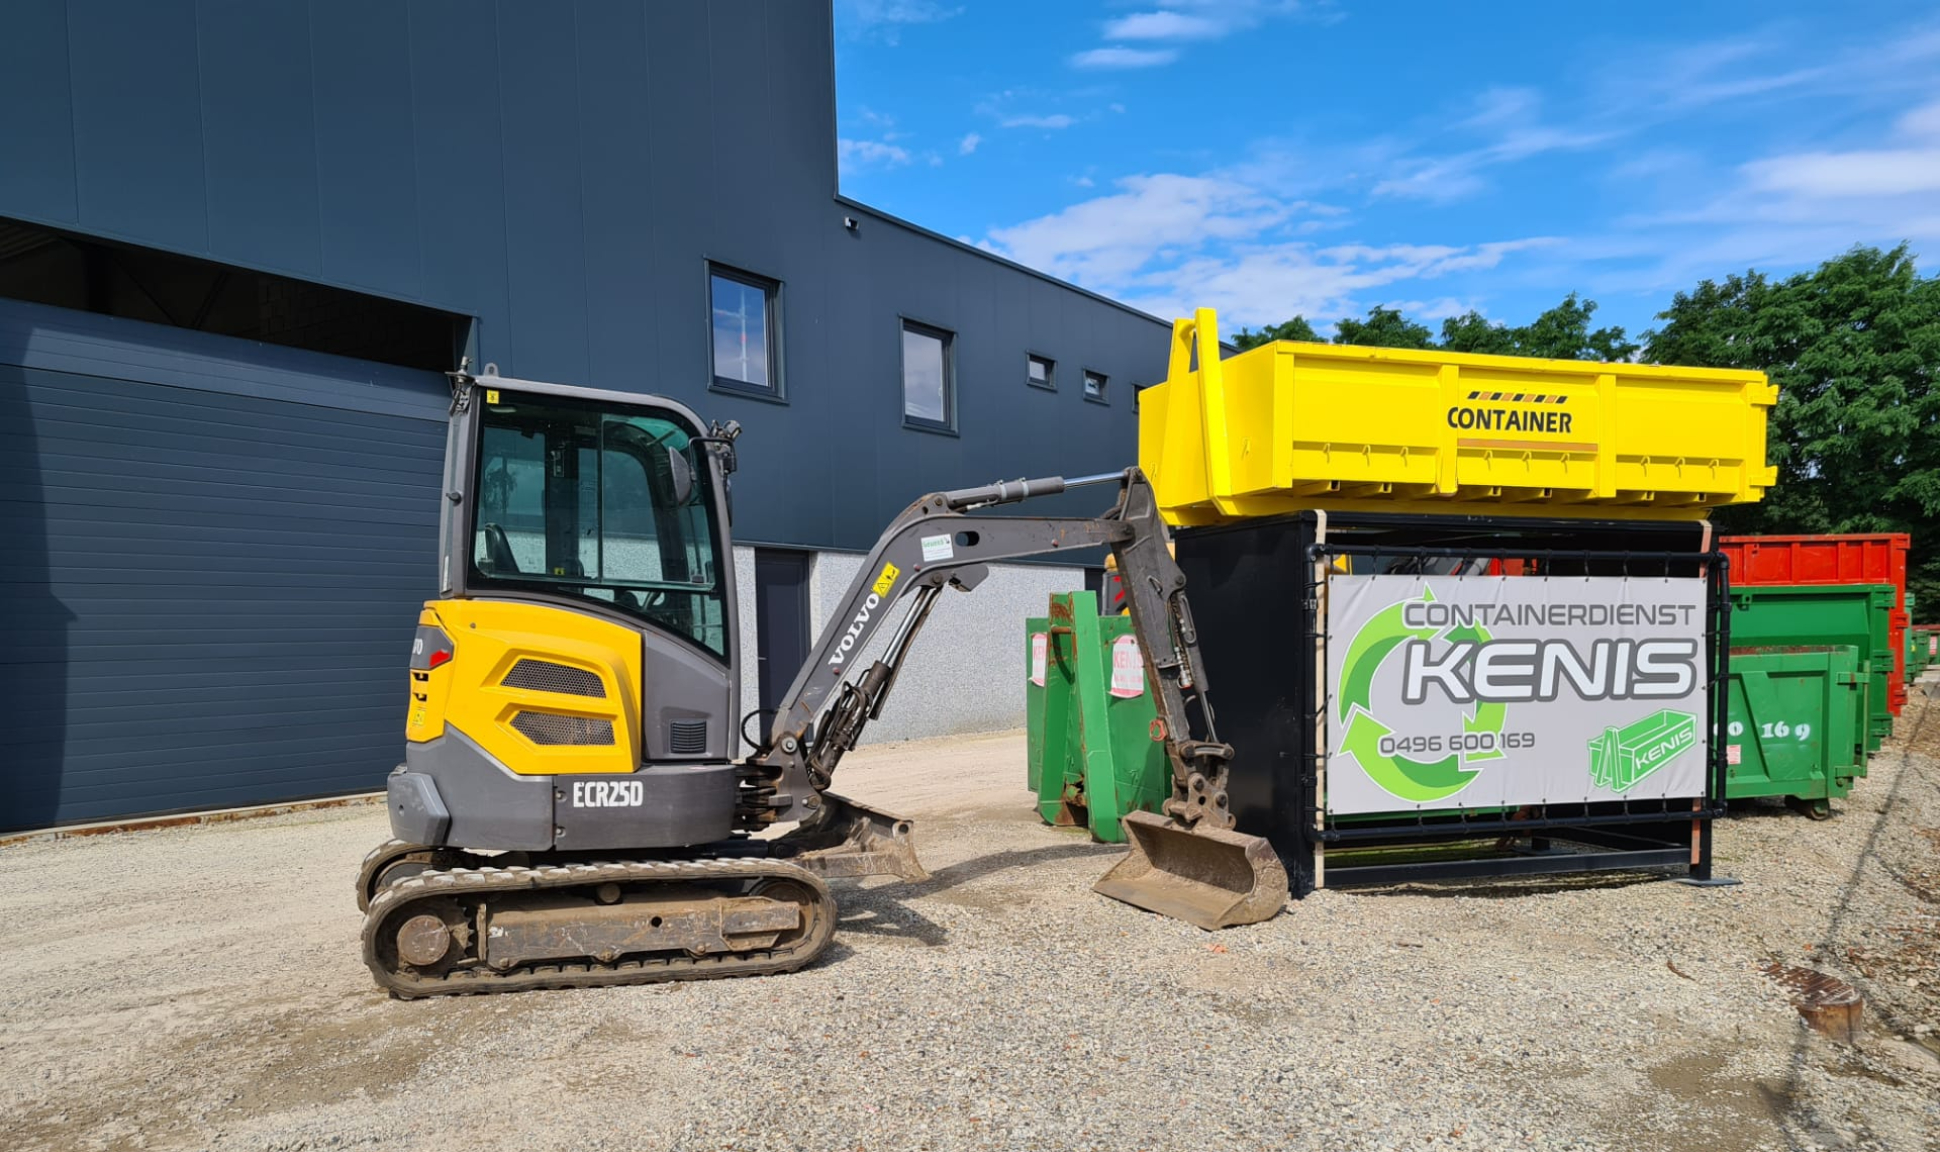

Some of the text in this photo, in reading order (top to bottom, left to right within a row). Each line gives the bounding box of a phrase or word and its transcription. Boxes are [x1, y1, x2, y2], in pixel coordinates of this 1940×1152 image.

[1447, 406, 1572, 433] CONTAINER
[1404, 603, 1696, 626] CONTAINERDIENST
[828, 593, 880, 665] VOLVO
[1402, 638, 1698, 705] KENIS
[1380, 733, 1536, 754] 0496 600 169
[1636, 727, 1693, 770] KENIS
[573, 781, 643, 808] ECR25D
